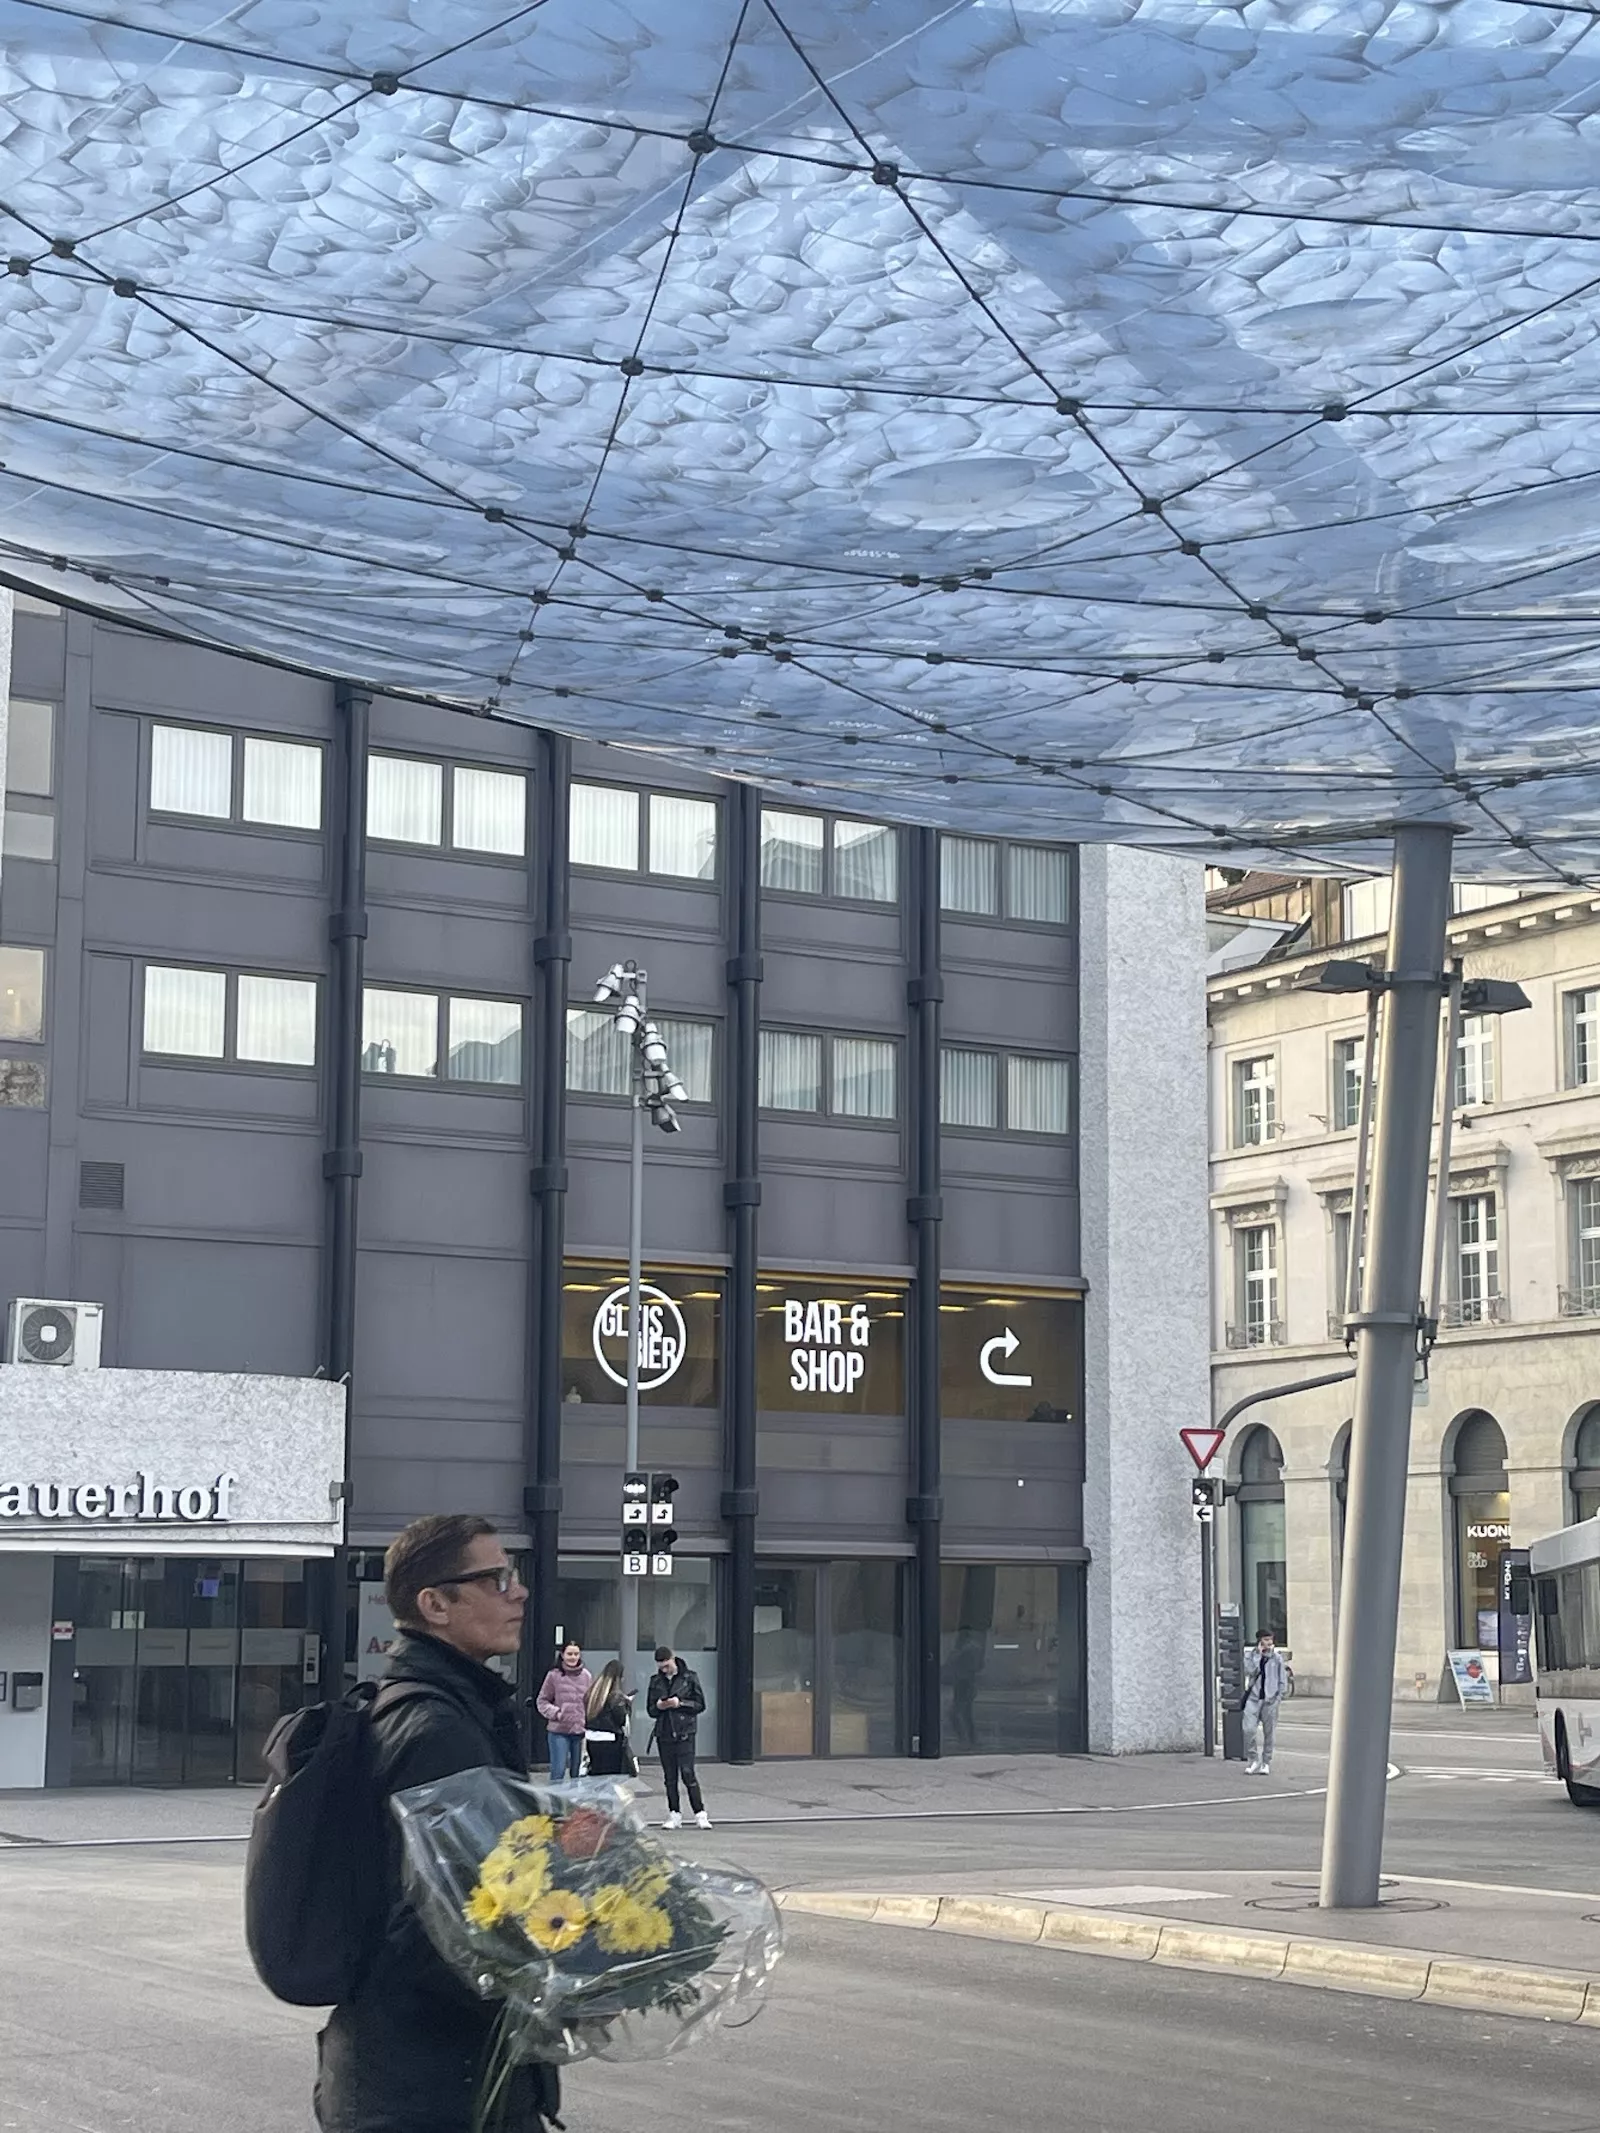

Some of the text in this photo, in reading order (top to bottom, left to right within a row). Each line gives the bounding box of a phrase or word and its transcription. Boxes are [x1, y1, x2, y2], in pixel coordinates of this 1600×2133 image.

[602, 1302, 664, 1337] GLIS
[785, 1299, 870, 1347] BAR &
[790, 1348, 865, 1394] SHOP
[0, 1471, 239, 1520] auerhof
[630, 1557, 641, 1572] B
[657, 1557, 668, 1572] D
